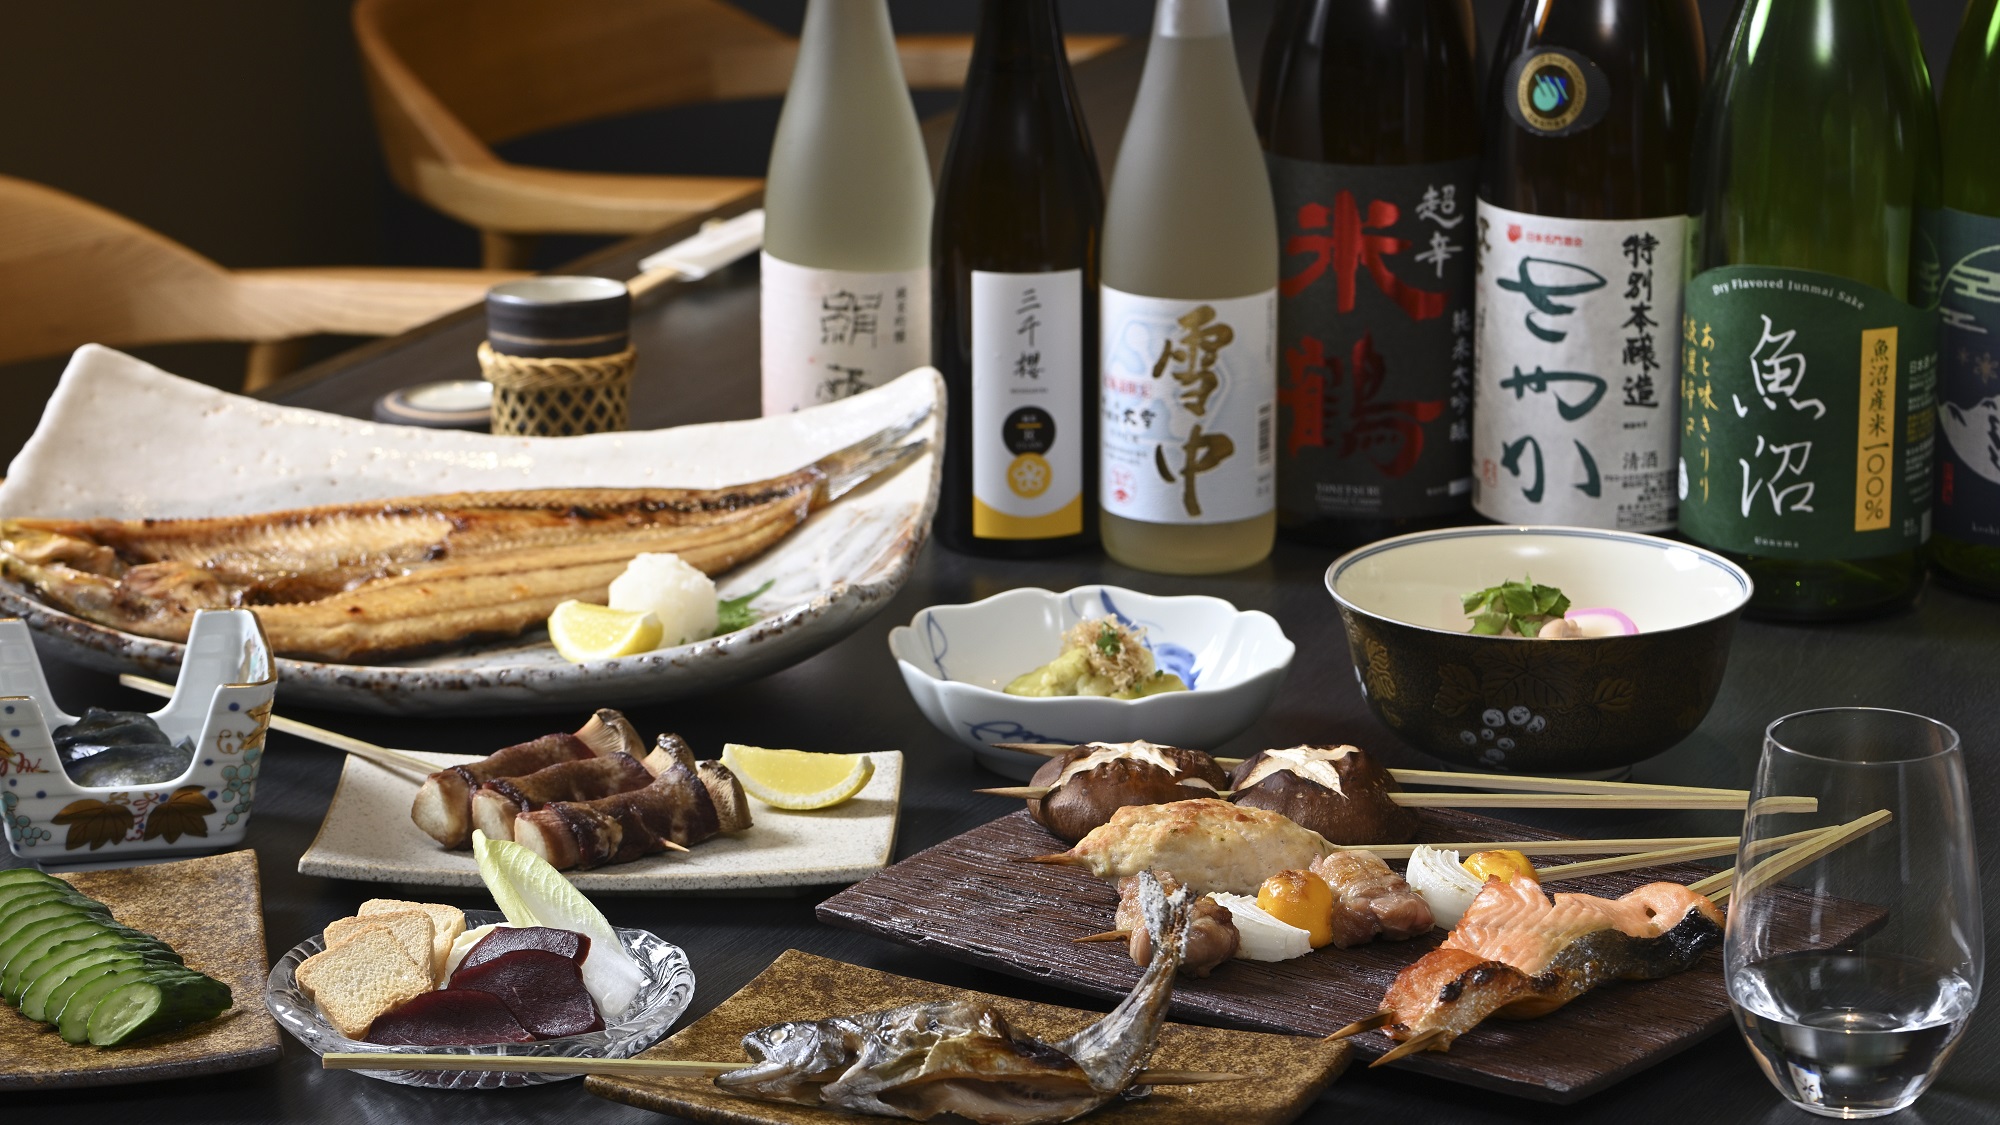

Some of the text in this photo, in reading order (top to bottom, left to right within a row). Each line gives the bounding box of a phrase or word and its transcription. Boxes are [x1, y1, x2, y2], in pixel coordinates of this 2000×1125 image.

[1415, 184, 1463, 278] 超辛
[1621, 231, 1660, 409] 特別本醸造
[1712, 278, 1865, 311] Dry Flavored Junmai Sake
[1013, 288, 1043, 380] 三千櫻
[1278, 189, 1448, 479] 米鶴
[1496, 256, 1608, 504] さやか
[1697, 323, 1719, 505] あと味きりり
[1732, 314, 1827, 518] 魚沼
[1623, 450, 1658, 471] 清酒
